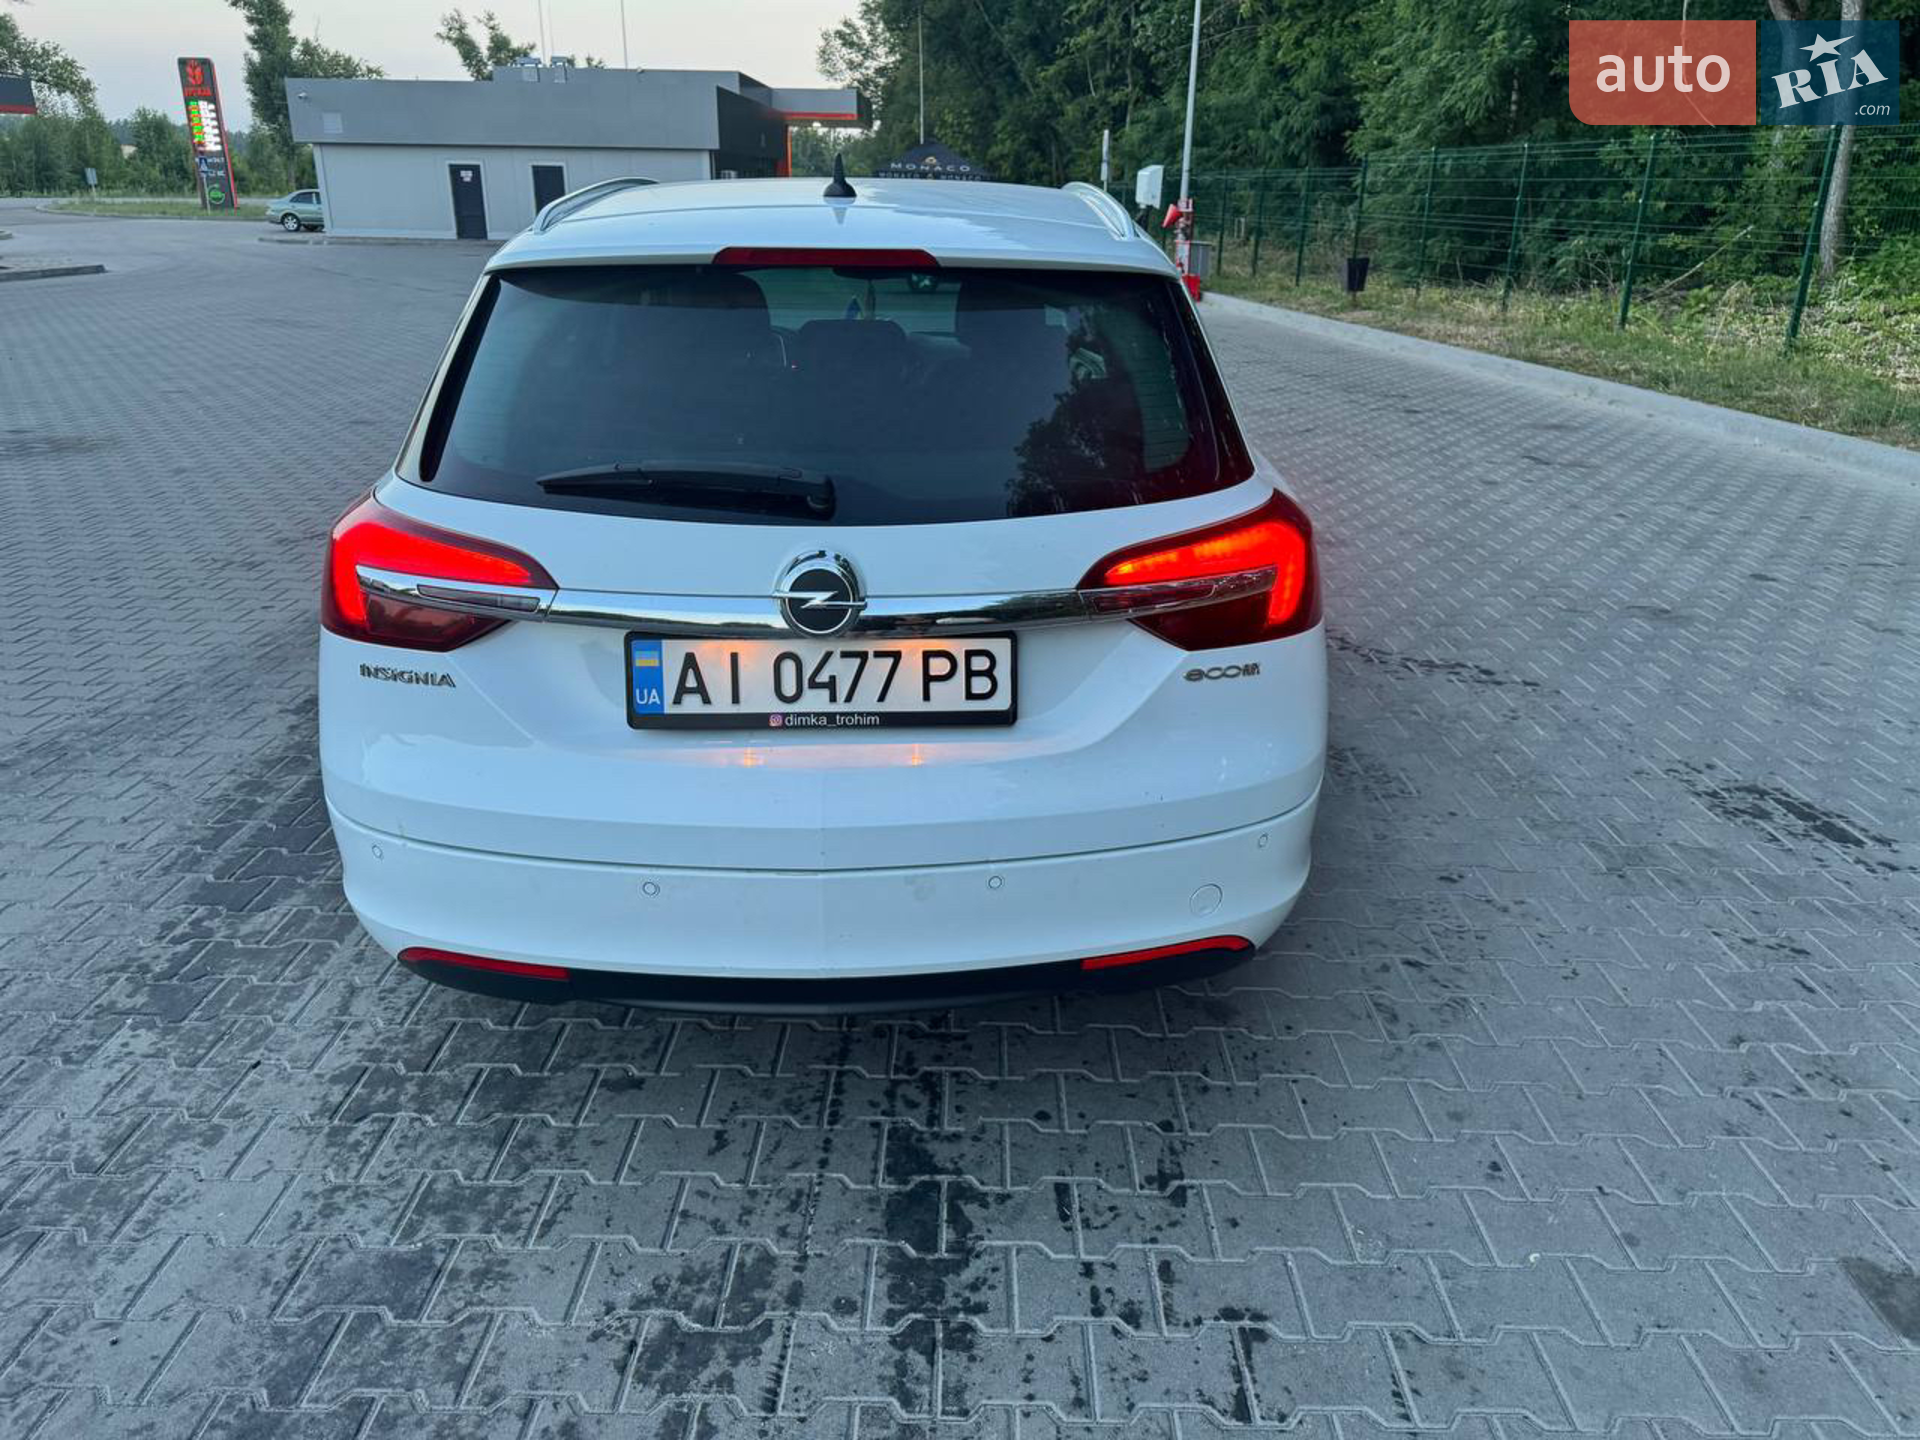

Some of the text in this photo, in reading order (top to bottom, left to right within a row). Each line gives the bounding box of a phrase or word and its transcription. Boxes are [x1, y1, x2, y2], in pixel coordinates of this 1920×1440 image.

[890, 162, 971, 172] MONACO
[359, 663, 456, 688] INSIGNIA
[672, 649, 998, 705] AI 0477 PB
[635, 689, 661, 705] UA
[785, 714, 880, 727] dimka_trohim
